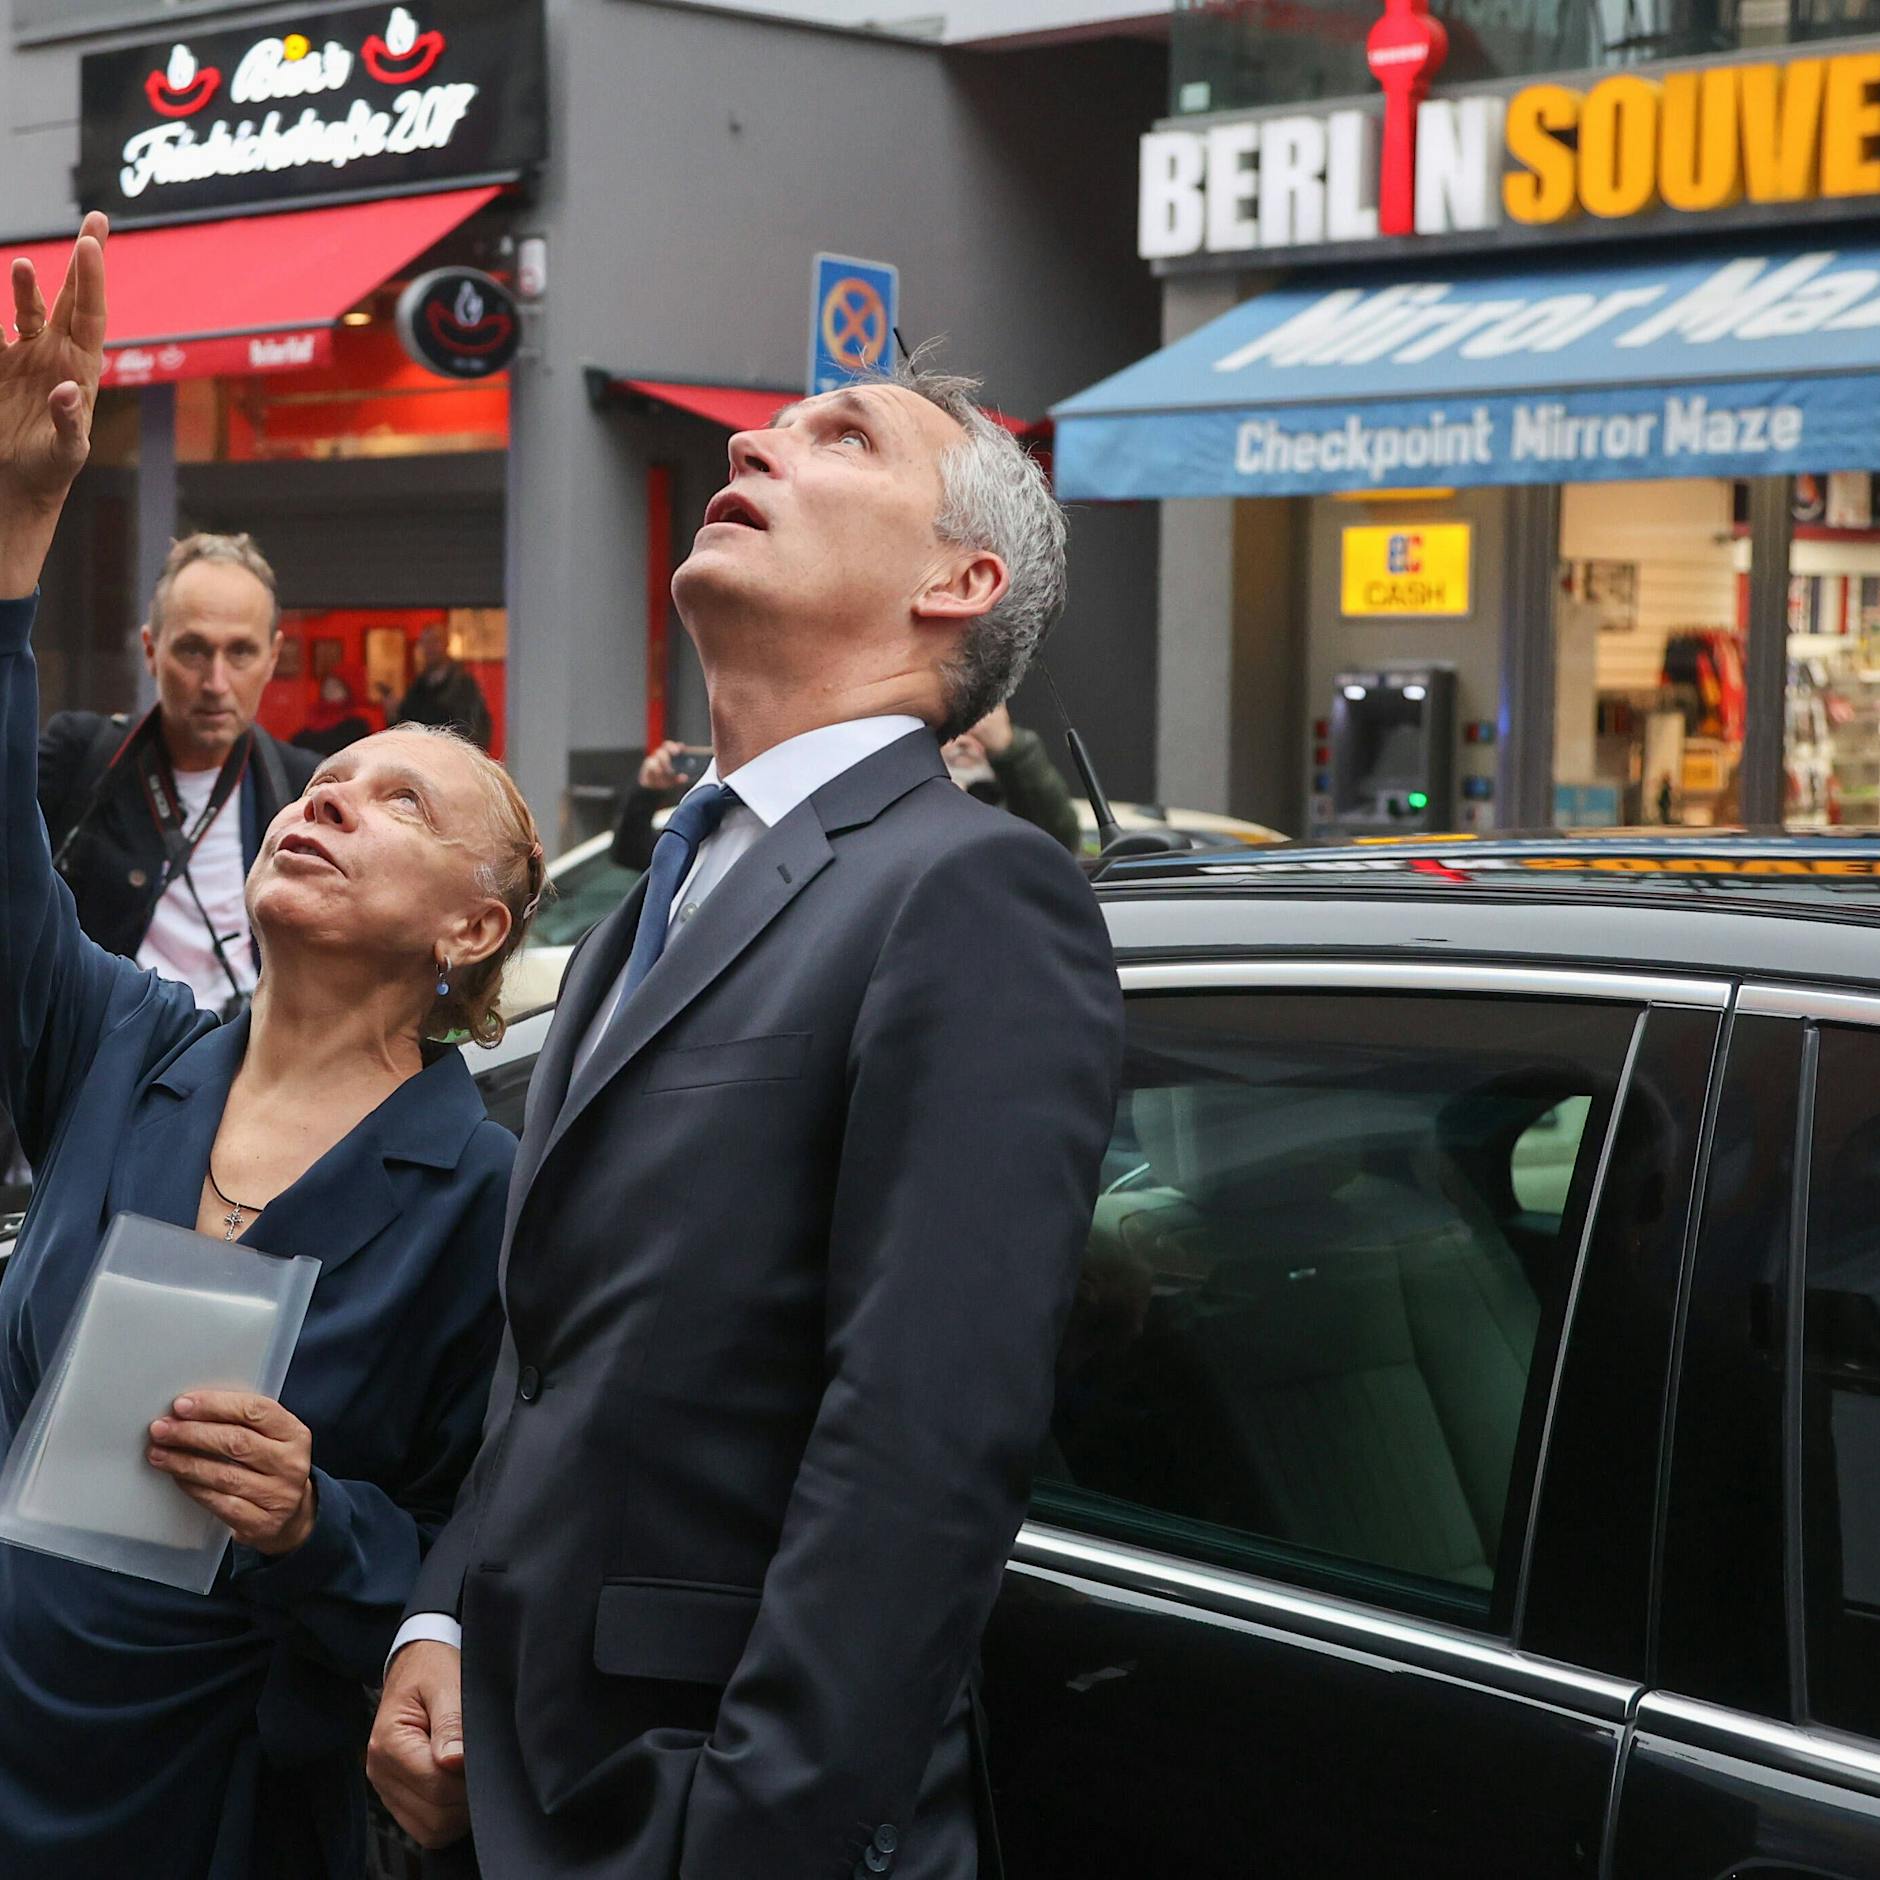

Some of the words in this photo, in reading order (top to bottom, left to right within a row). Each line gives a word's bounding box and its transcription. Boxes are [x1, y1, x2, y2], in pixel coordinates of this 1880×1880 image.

[386, 82, 478, 154] 207
[1138, 92, 1506, 260] BERLIN
[1213, 282, 1669, 373] Mirror
[1614, 251, 1880, 348] Ma
[1234, 406, 1493, 482] Checkpoint
[1510, 403, 1658, 461] Mirror
[1663, 395, 1804, 457] Maze
[1363, 580, 1447, 607] CASH
